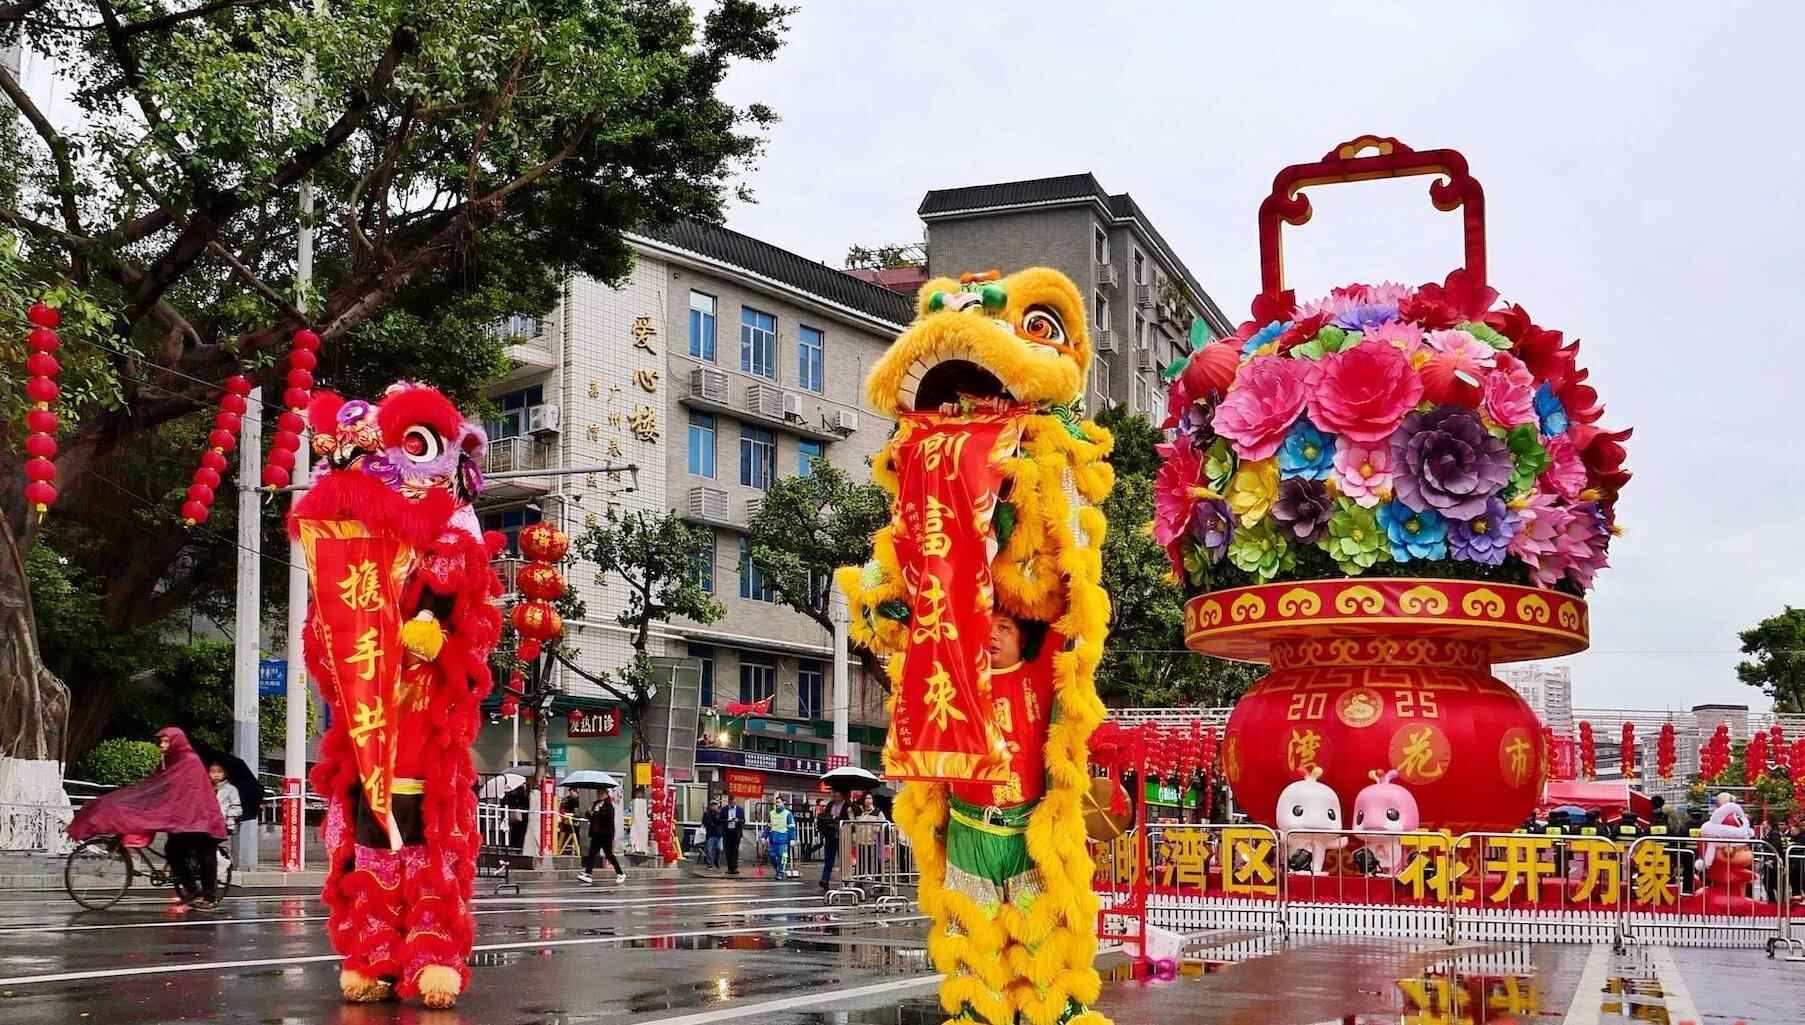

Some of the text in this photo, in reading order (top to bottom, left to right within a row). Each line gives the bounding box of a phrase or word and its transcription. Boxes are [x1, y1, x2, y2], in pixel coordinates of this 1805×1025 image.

[1288, 690, 1439, 721] 20 25
[1395, 828, 1677, 907] 花开万象
